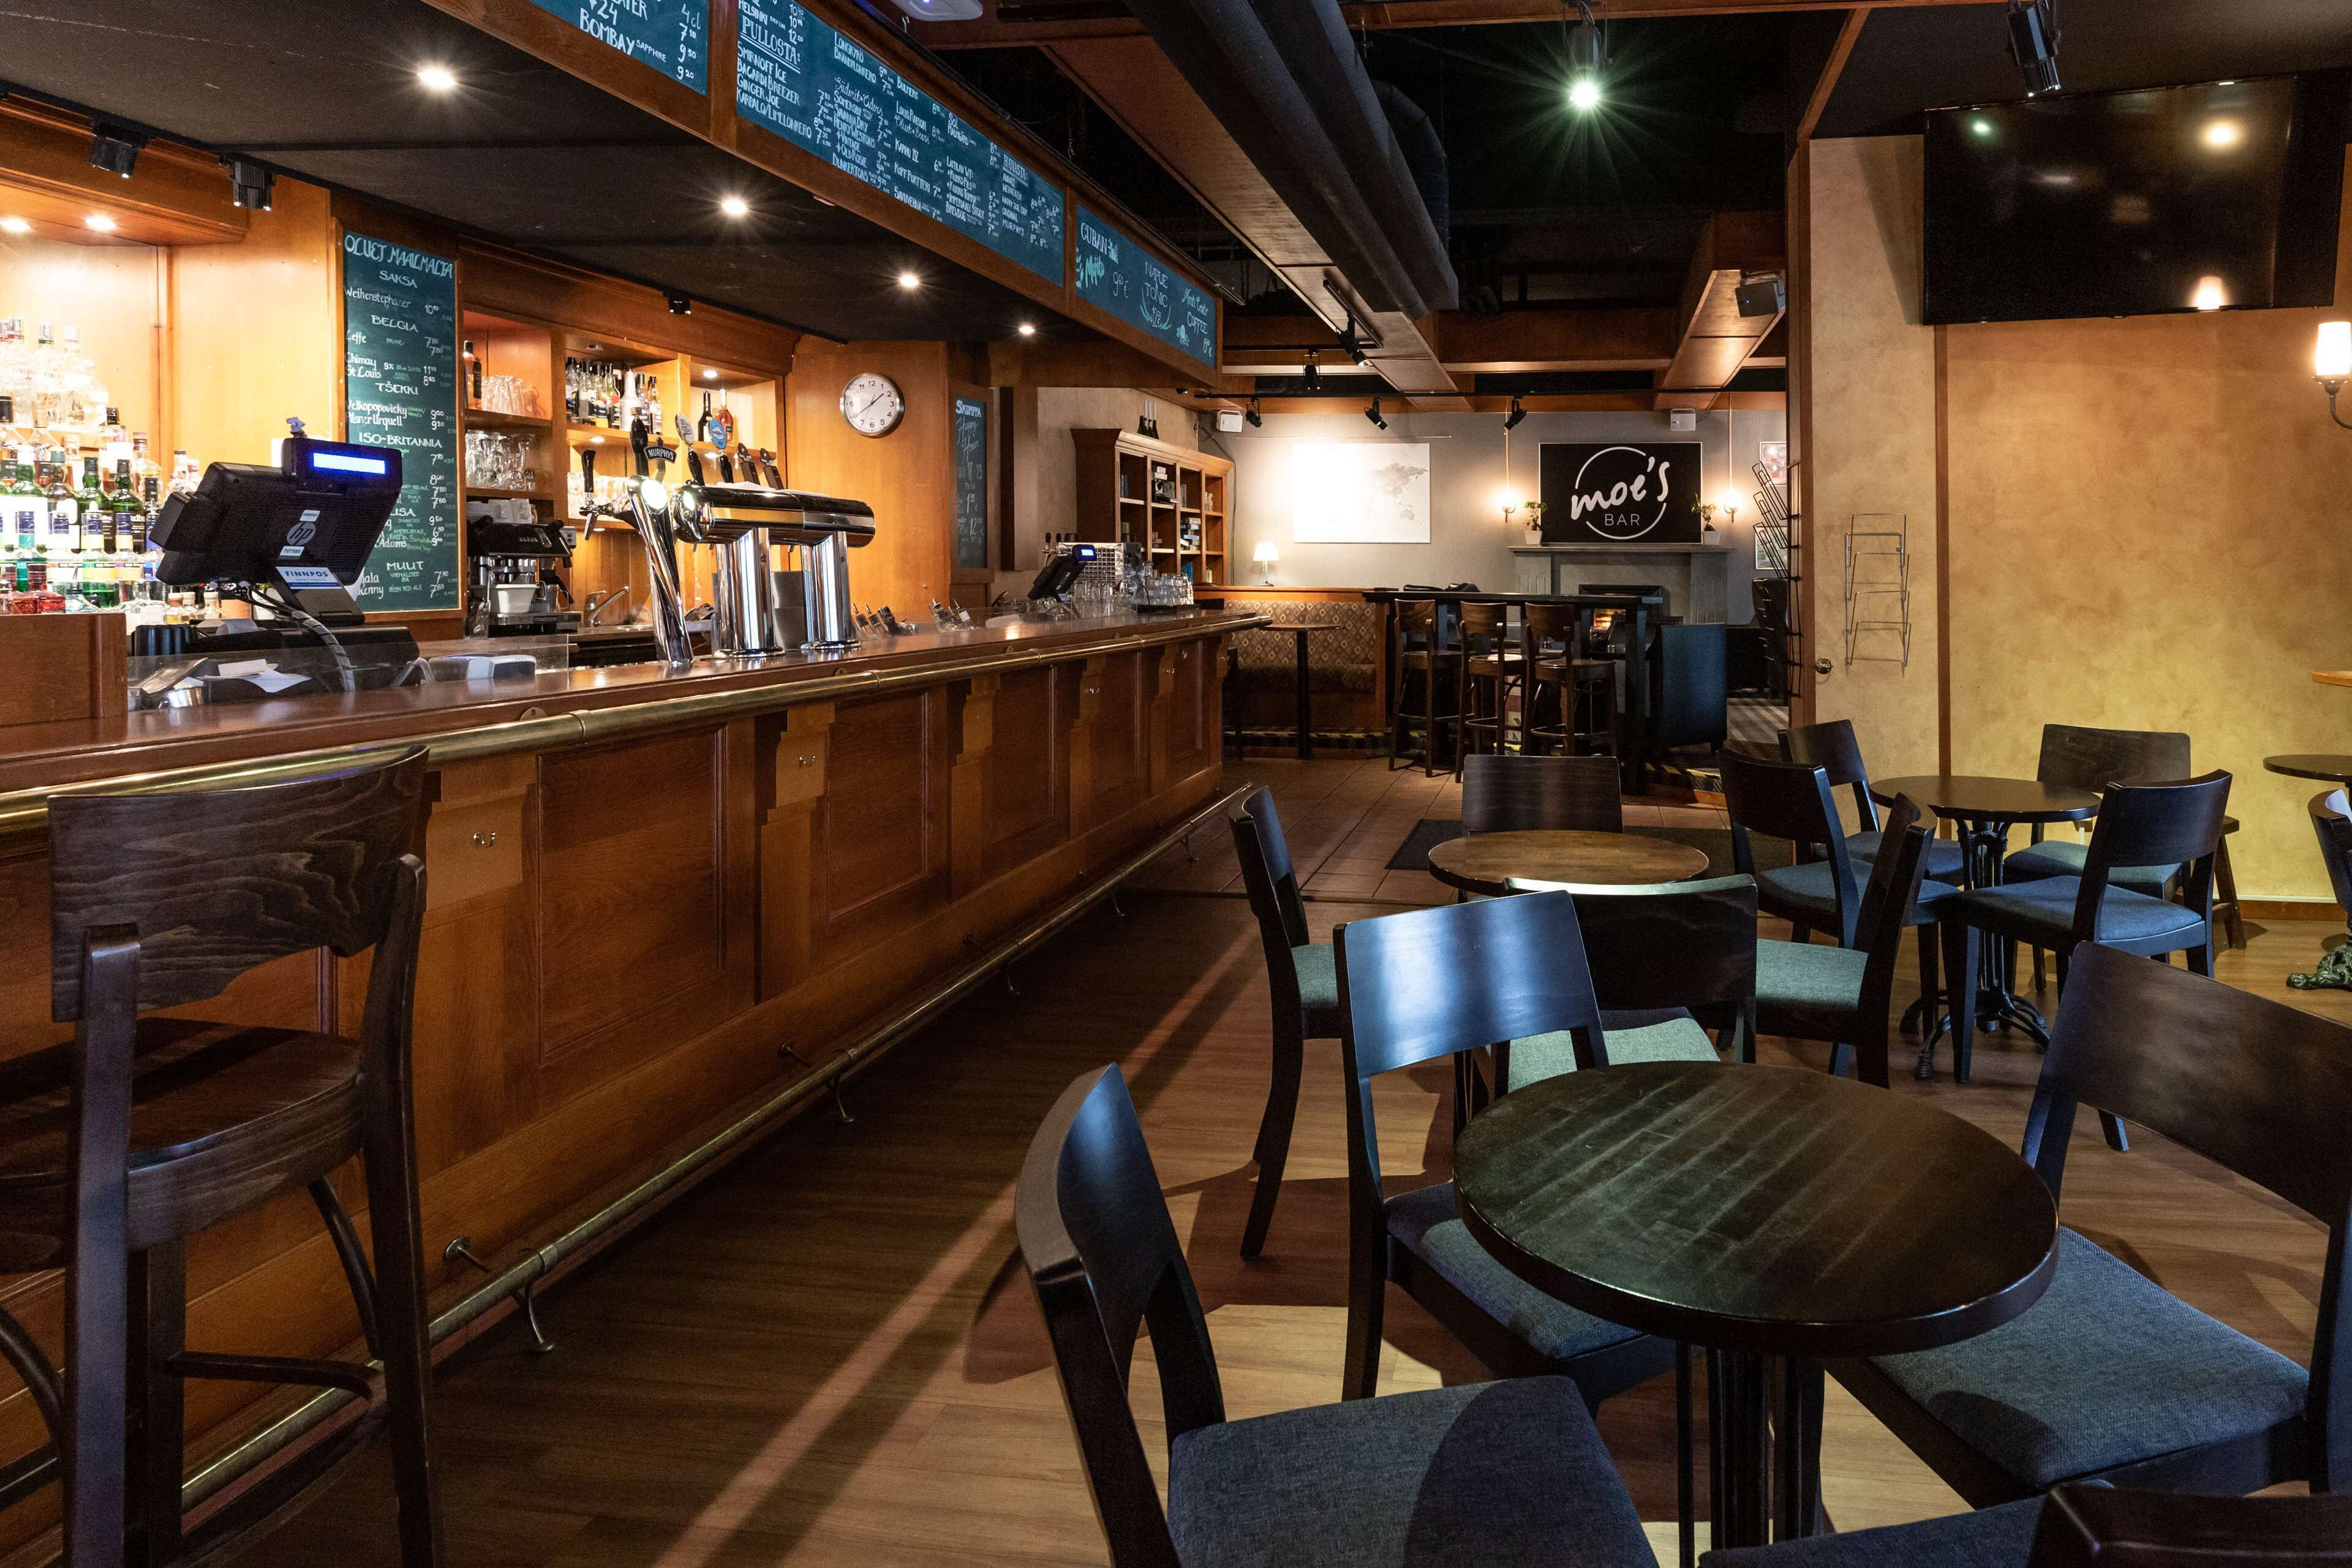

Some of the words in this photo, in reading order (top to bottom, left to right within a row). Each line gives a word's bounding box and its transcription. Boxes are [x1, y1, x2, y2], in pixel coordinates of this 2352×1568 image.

[580, 7, 635, 56] BOMBAY
[636, 40, 666, 62] SAPPHIRE
[742, 15, 801, 65] PULLOSTA:
[737, 41, 774, 75] SMIRNOFF
[775, 63, 787, 83] ICE
[737, 57, 767, 87] BACARDI
[768, 75, 800, 106] BREEZER
[737, 74, 765, 100] GINGER
[766, 90, 780, 109] JOE
[858, 116, 868, 132] DRY
[1002, 218, 1024, 236] MURPHYS
[1081, 222, 1107, 255] CUBAN
[344, 235, 386, 262] OLUET
[387, 247, 453, 279] MAAILMALTA
[380, 270, 418, 289] SAKSA
[1145, 282, 1168, 308] TONIC
[371, 315, 419, 333] BELGIA
[357, 366, 382, 379] Louis
[375, 381, 418, 395] TŠEKKI
[956, 400, 981, 417] SKUMPPA
[373, 415, 403, 431] Urquell
[648, 448, 674, 461] MURPHYS
[1605, 513, 1640, 526] BAR
[380, 538, 407, 548] Adams
[386, 561, 424, 571] MUUT
